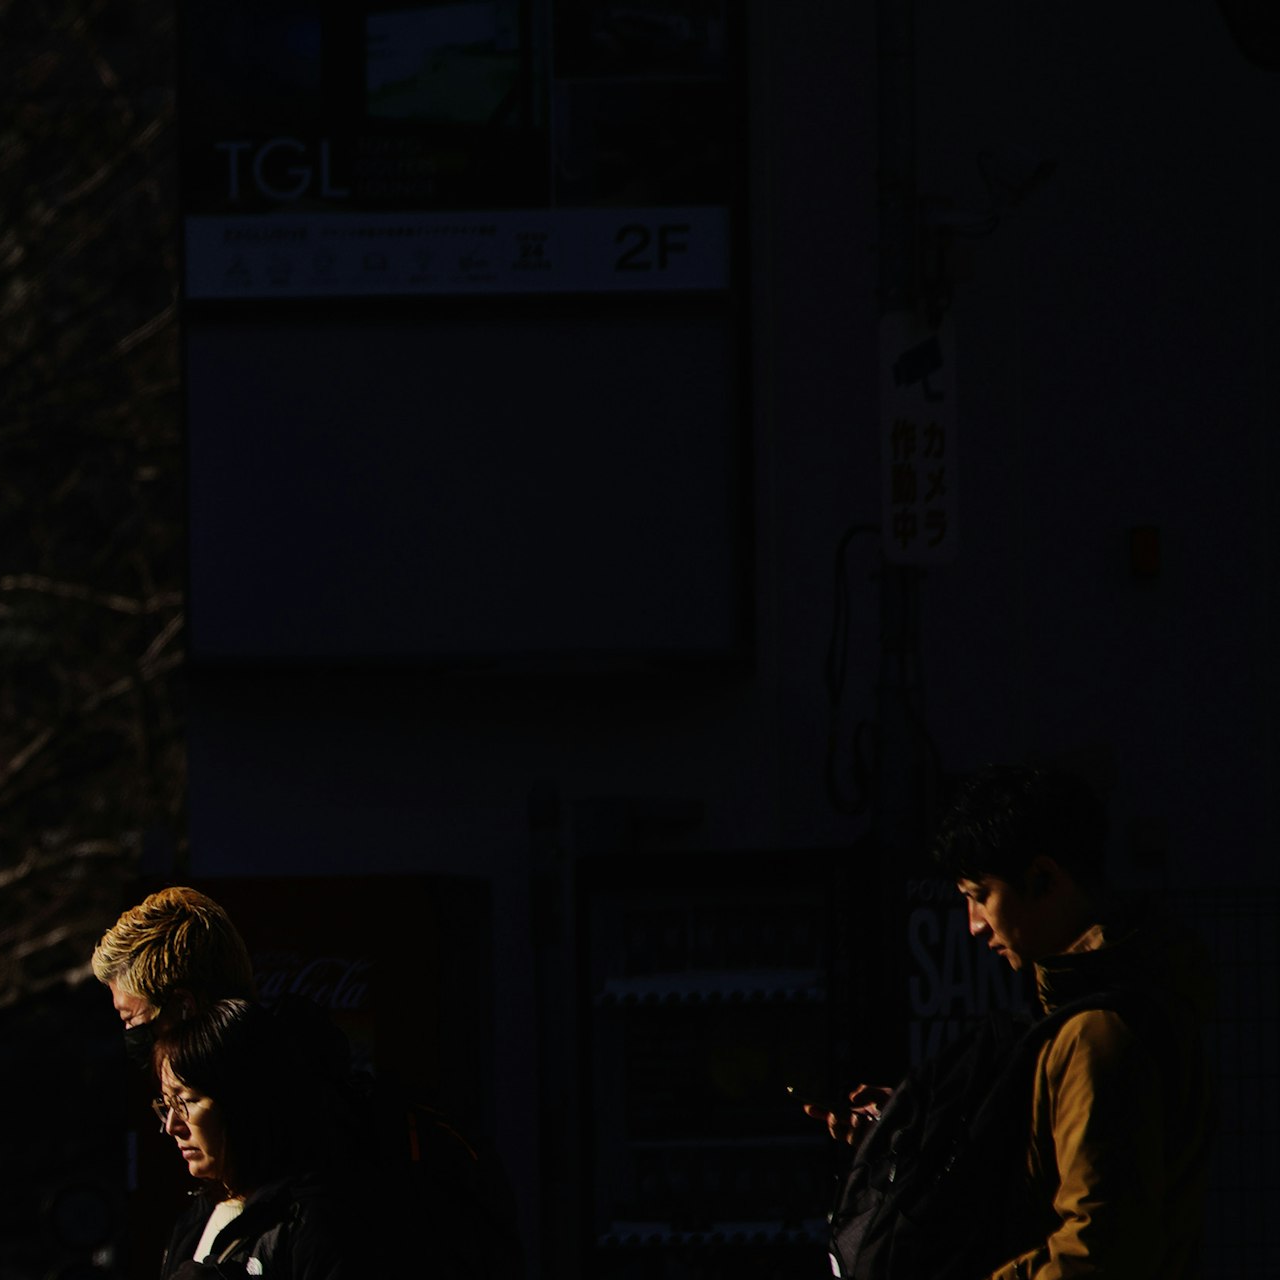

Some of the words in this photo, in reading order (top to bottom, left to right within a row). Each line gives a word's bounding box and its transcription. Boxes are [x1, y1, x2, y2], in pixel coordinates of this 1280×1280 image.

[214, 136, 351, 201] TGL
[614, 224, 690, 272] 2F
[891, 418, 917, 551] 作動中
[923, 421, 948, 548] カメラ
